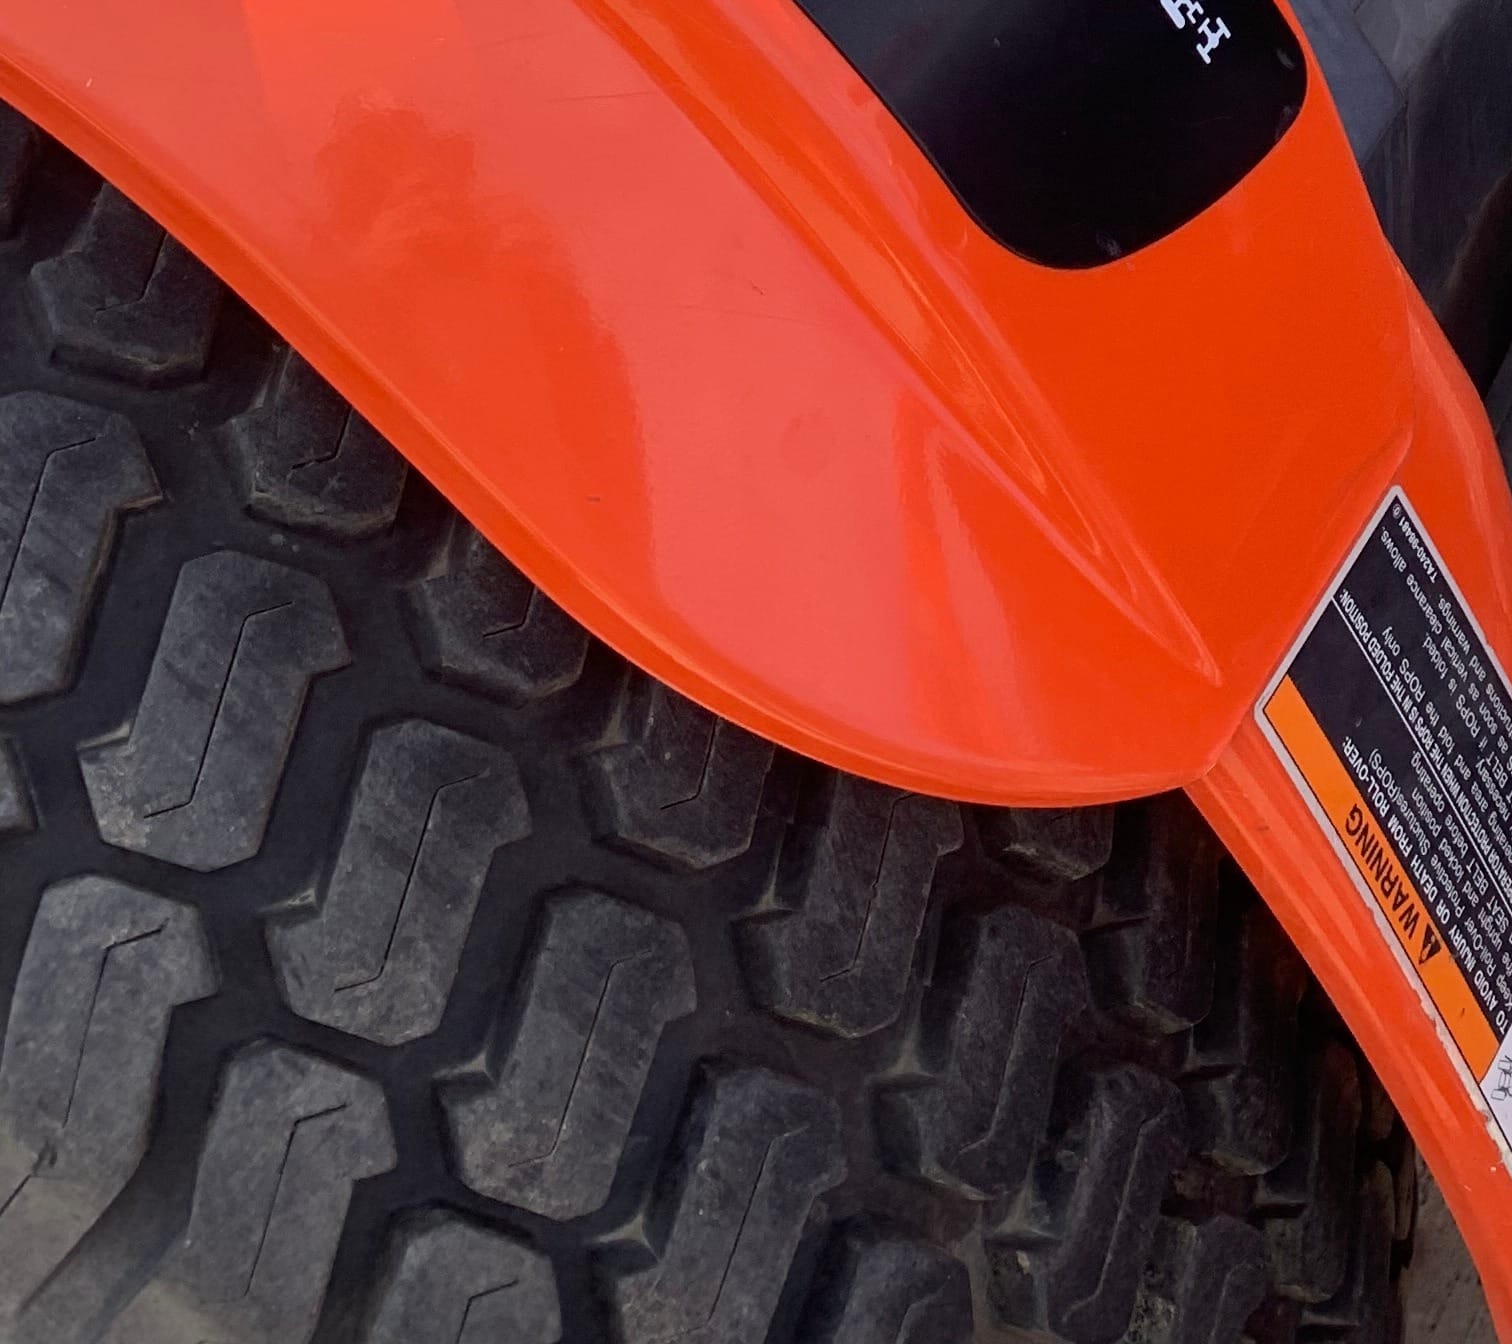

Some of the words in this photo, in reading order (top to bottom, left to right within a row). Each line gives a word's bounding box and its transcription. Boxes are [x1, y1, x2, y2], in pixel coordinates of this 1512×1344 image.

[1380, 525, 1406, 572] allows.
[1338, 588, 1372, 643] POSITION:
[1406, 573, 1442, 635] clearance
[1435, 593, 1470, 655] warnings.
[1367, 636, 1395, 682] FOLDED
[1381, 625, 1400, 656] only
[1421, 631, 1448, 679] folded.
[1439, 635, 1468, 682] vertical
[1389, 673, 1406, 703] THE
[1398, 657, 1426, 703] ROPS
[1447, 678, 1457, 696] is
[1468, 654, 1486, 681] and
[1401, 693, 1413, 714] IN
[1467, 682, 1479, 701] as
[1407, 705, 1419, 723] IS
[1413, 715, 1435, 753] ROPS
[1425, 701, 1439, 727] the
[1455, 693, 1481, 738] ROPS
[1478, 701, 1498, 734] soon
[1428, 742, 1445, 771] THE
[1436, 725, 1455, 755] fold
[1477, 735, 1488, 751] if
[1496, 735, 1508, 754] as
[1341, 735, 1390, 818] ROLL-OVER:
[1410, 750, 1445, 813] operating.
[1439, 762, 1460, 798] WHEN
[1453, 753, 1471, 780] and
[1484, 751, 1508, 788] BELT
[1470, 780, 1488, 812] area
[1474, 755, 1510, 822] necessary.
[1411, 786, 1442, 838] position
[1455, 790, 1493, 856] PROTECTION
[1387, 813, 1413, 858] FROM
[1444, 813, 1468, 859] before
[1345, 803, 1419, 939] WARNING
[1409, 853, 1438, 903] DEATH
[1437, 837, 1464, 883] locked
[1465, 857, 1489, 896] BELT
[1430, 853, 1465, 918] Protective
[1461, 879, 1479, 907] and
[1435, 898, 1450, 924] OR
[1477, 906, 1502, 952] upright
[1485, 895, 1509, 933] SEAT
[1447, 923, 1476, 972] INJURY
[1463, 916, 1496, 977] Roll-Over
[1473, 969, 1498, 1011] AVOID
[1495, 1009, 1509, 1035] TO
